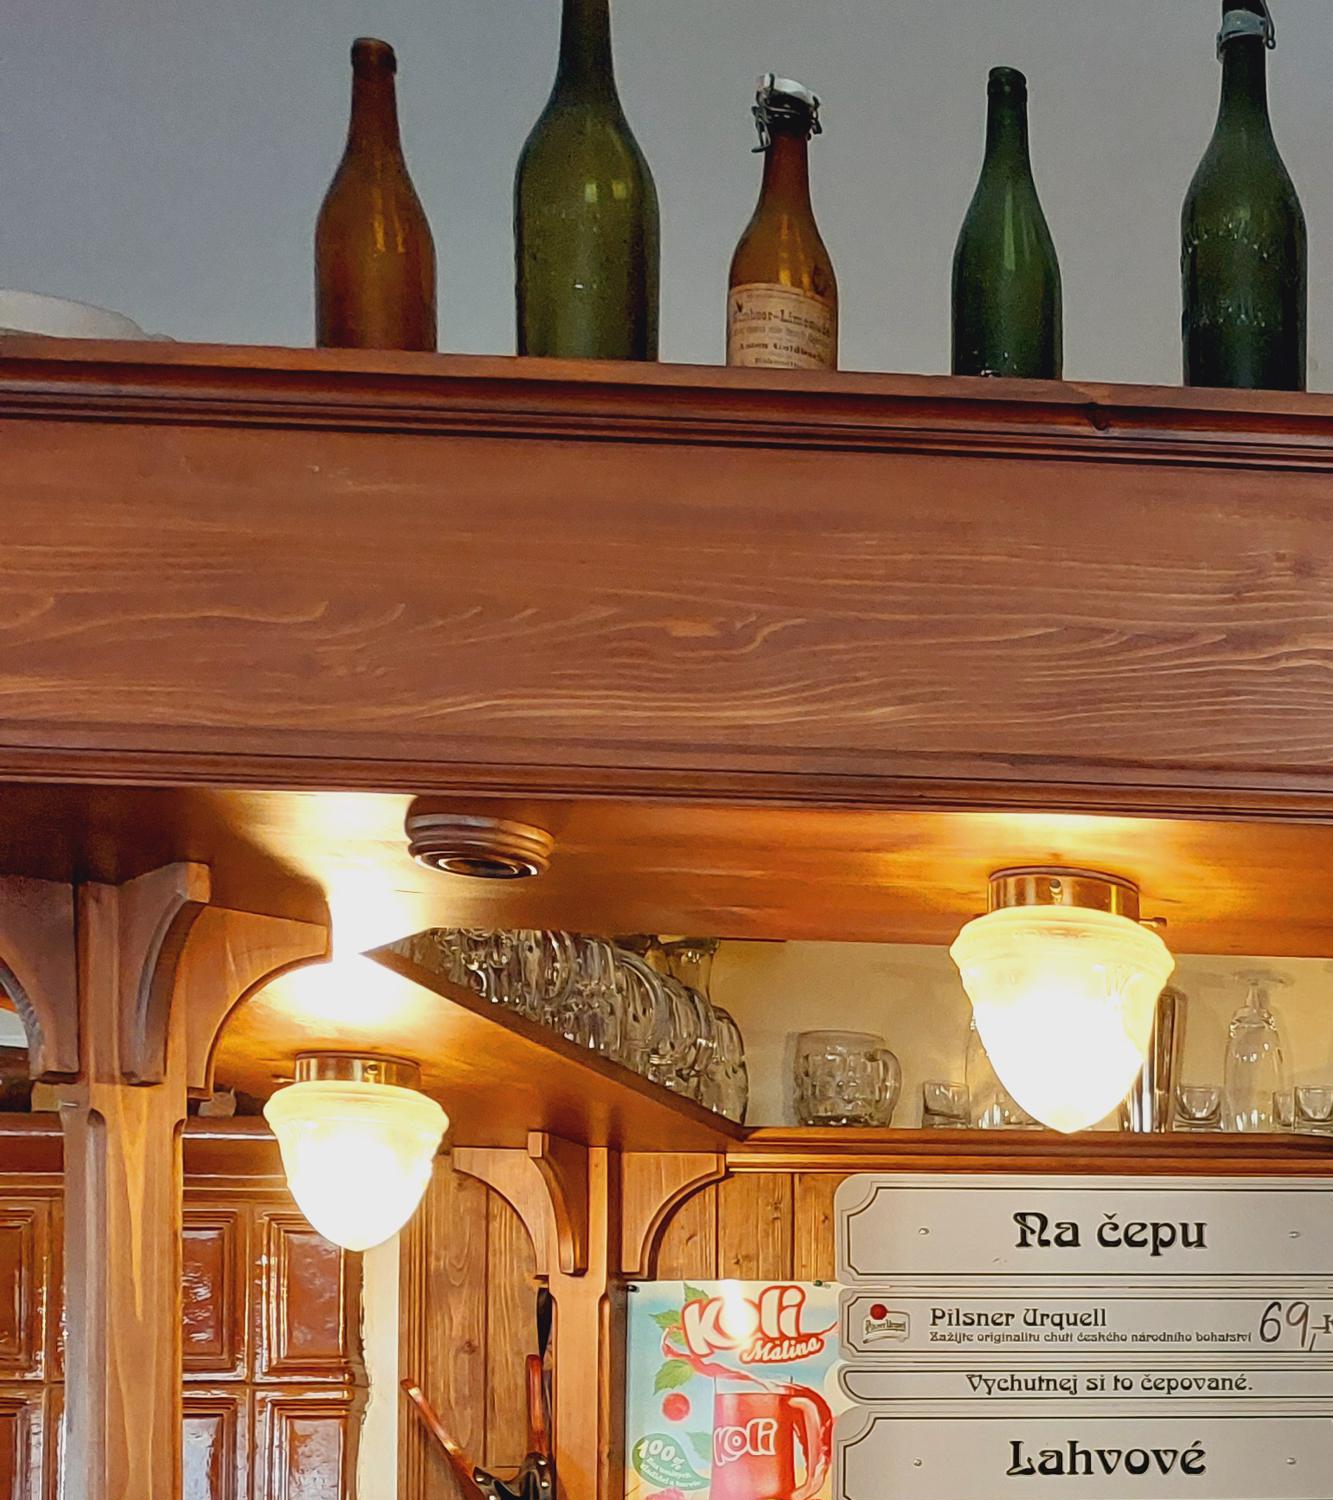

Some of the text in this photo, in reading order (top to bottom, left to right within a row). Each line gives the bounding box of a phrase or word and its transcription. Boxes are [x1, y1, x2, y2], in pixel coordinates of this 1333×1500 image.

[1013, 1212, 1207, 1256] Na čepu
[930, 1308, 1107, 1330] Pilsner Urquell
[930, 1331, 974, 1344] Zažijte
[977, 1331, 1040, 1344] originalitu
[1077, 1331, 1128, 1343] českého
[1131, 1331, 1192, 1342] národního
[1196, 1331, 1252, 1342] bohatství
[966, 1373, 1253, 1395] Vychutnej si to čepované.
[1006, 1438, 1206, 1478] Lahvové
